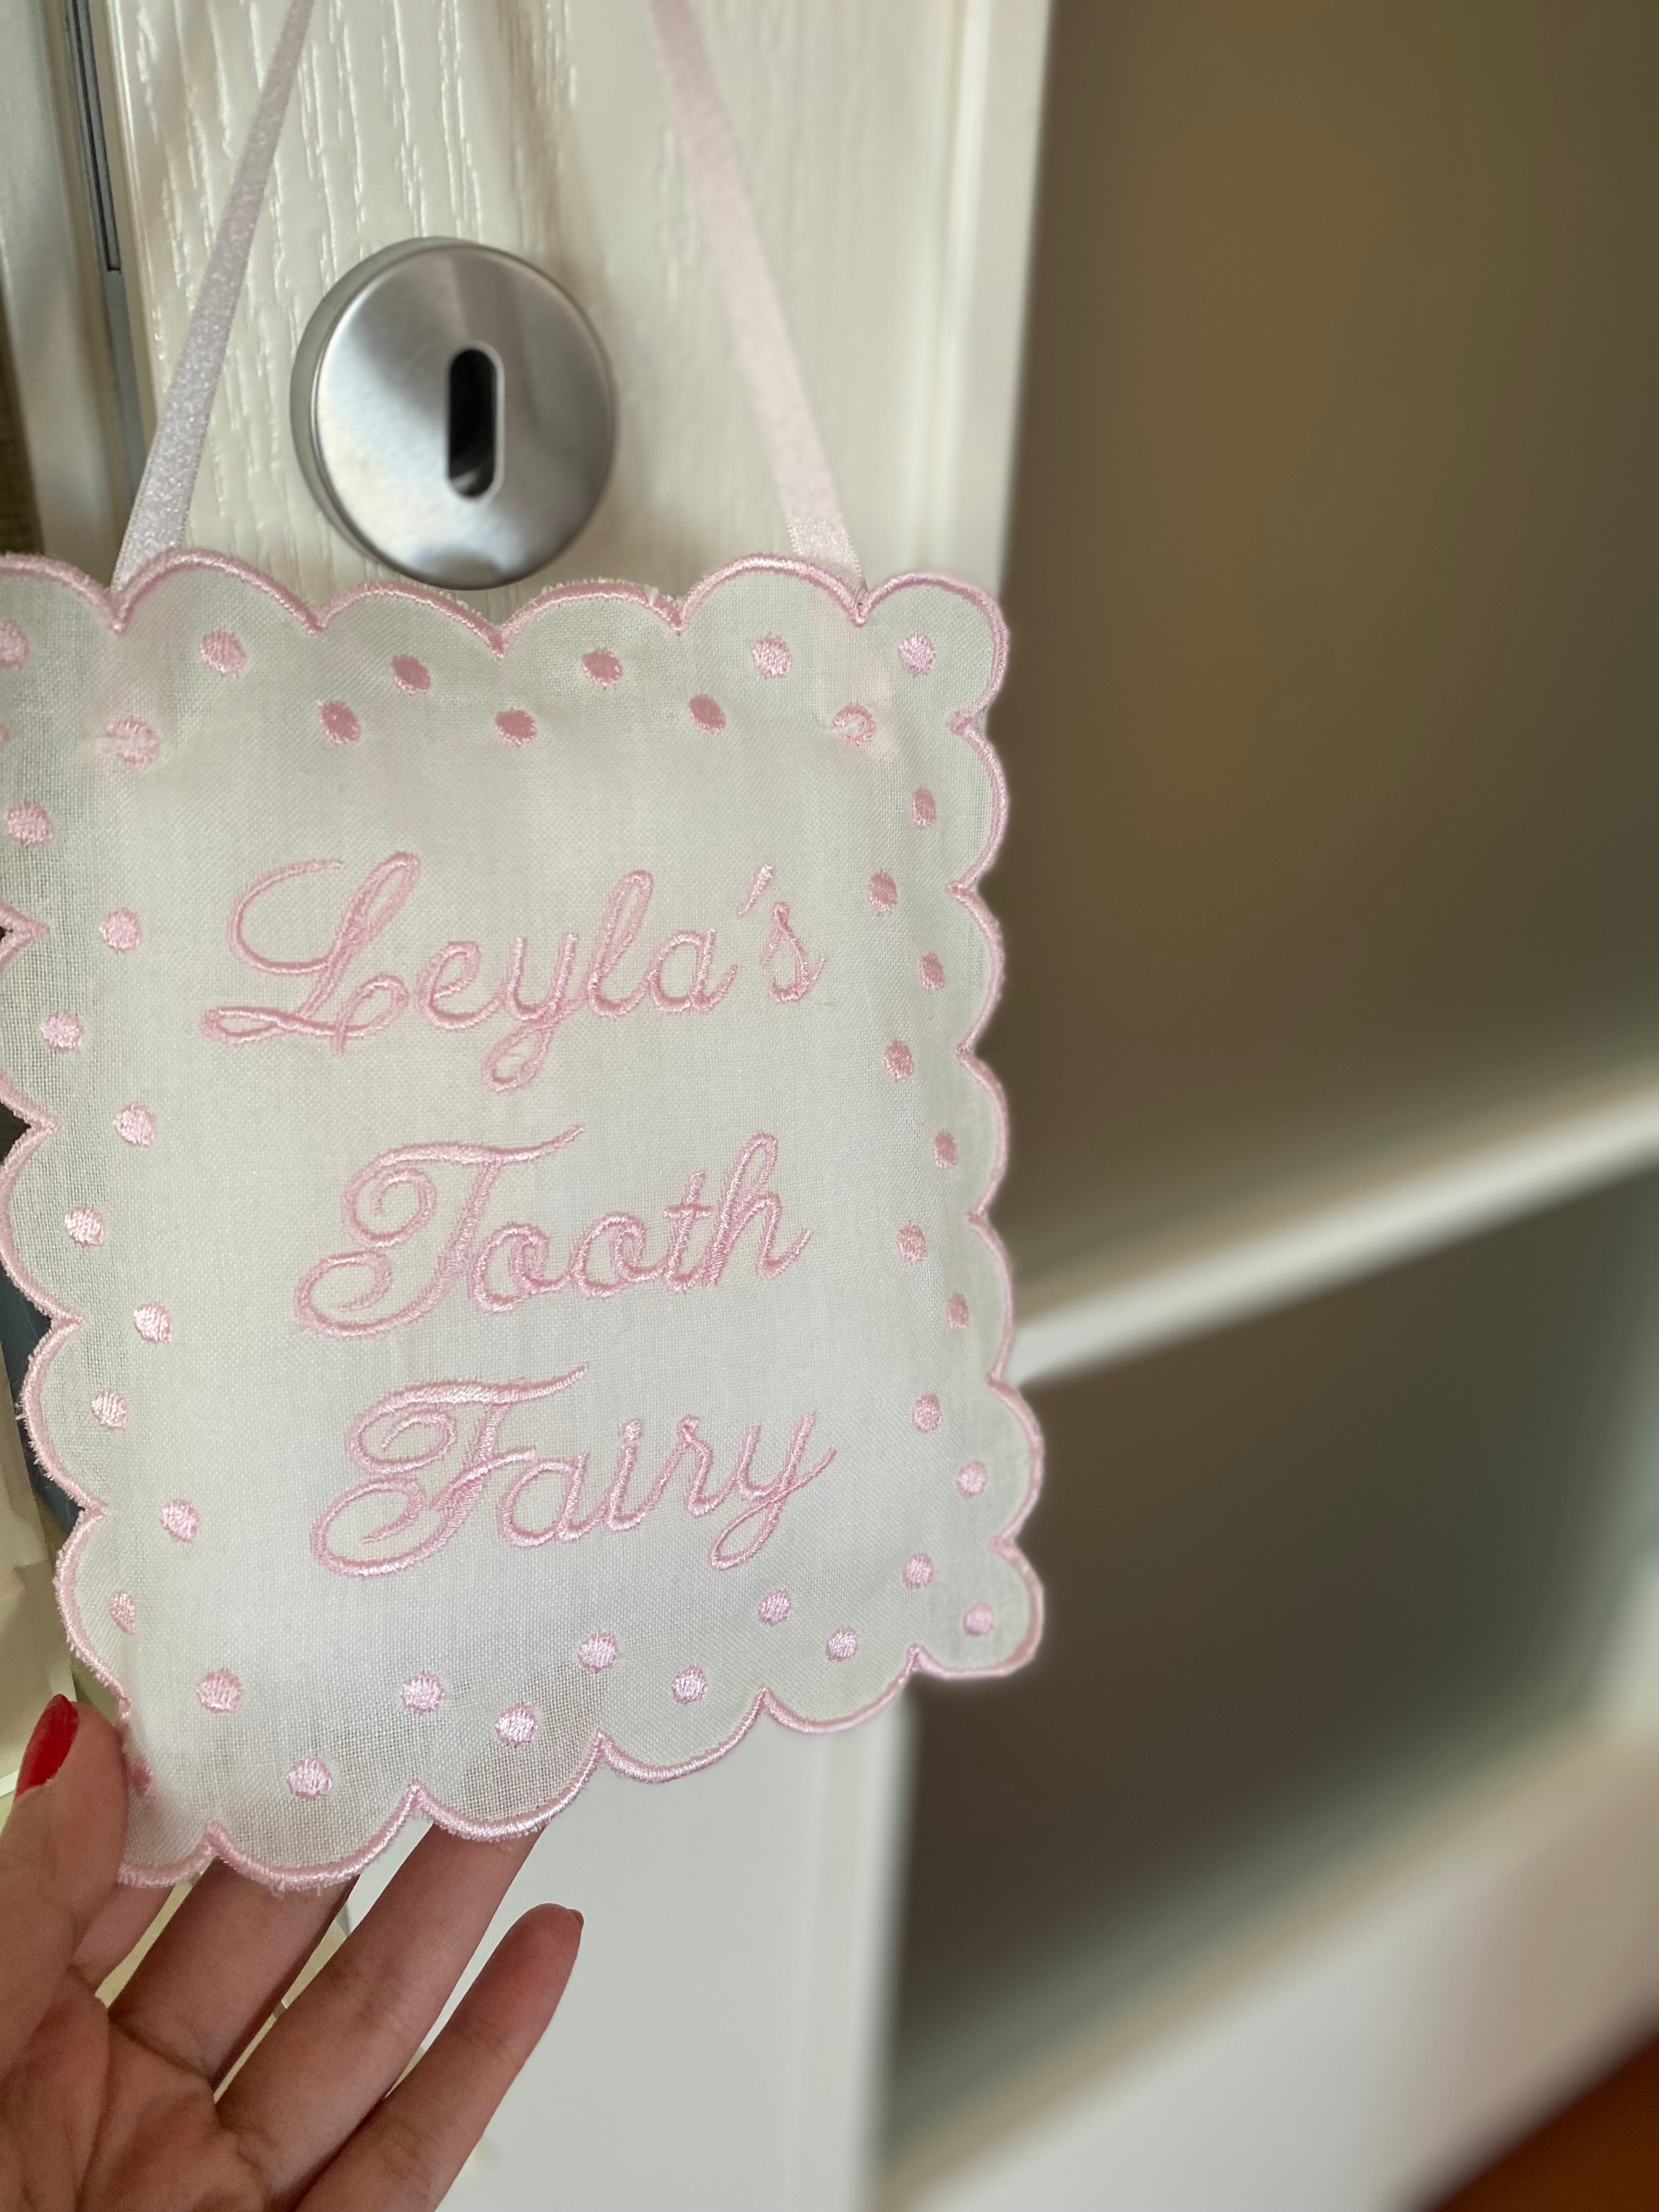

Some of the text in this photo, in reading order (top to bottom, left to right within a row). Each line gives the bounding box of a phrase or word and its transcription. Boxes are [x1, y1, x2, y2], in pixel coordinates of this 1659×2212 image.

[200, 851, 826, 1093] Leyla's
[294, 1124, 812, 1339] Tooth
[310, 1363, 837, 1578] Fairy
